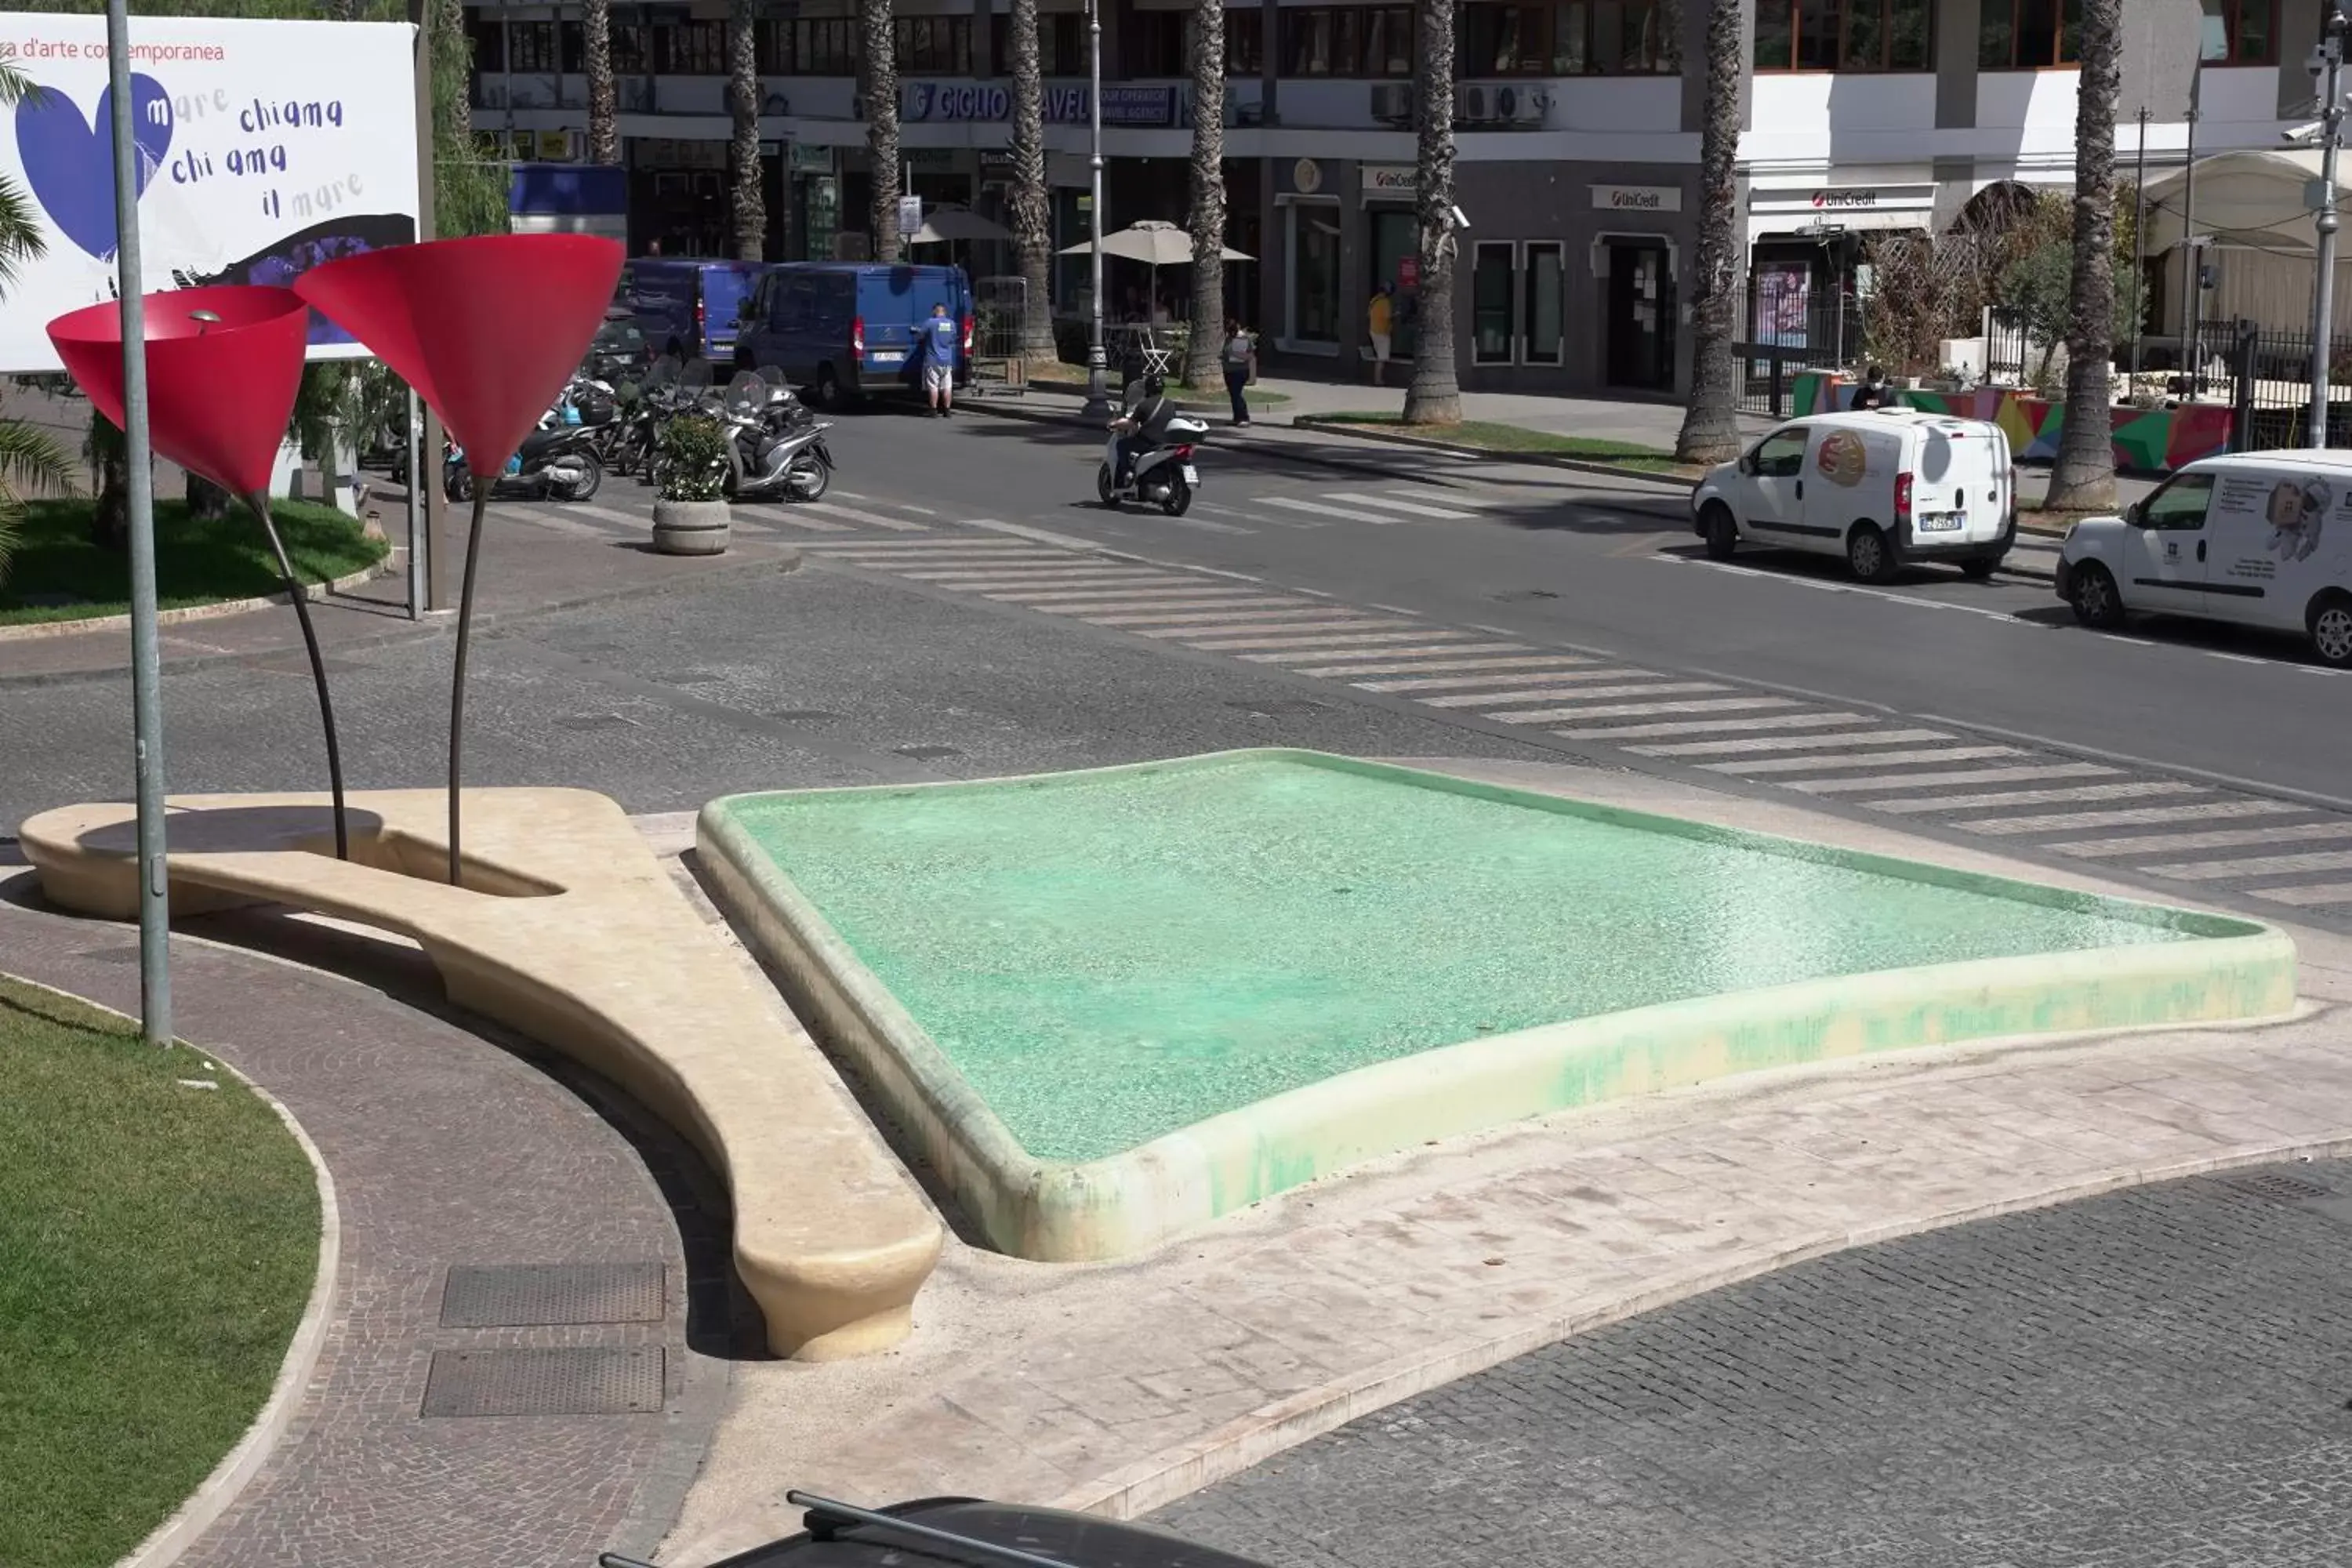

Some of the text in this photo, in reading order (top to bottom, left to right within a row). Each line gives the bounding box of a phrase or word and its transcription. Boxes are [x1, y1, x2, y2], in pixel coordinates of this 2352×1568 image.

[23, 37, 78, 58] d'arte
[84, 43, 225, 67] coemporanea
[147, 88, 343, 132] mare chiama
[941, 87, 1009, 119] GIGLIO
[1040, 87, 1087, 119] AVEL
[1100, 89, 1120, 102] OUR
[172, 144, 286, 184] chi ama
[263, 172, 364, 219] il mare
[1622, 193, 1659, 208] UniCredit
[1826, 191, 1875, 206] UniCredit
